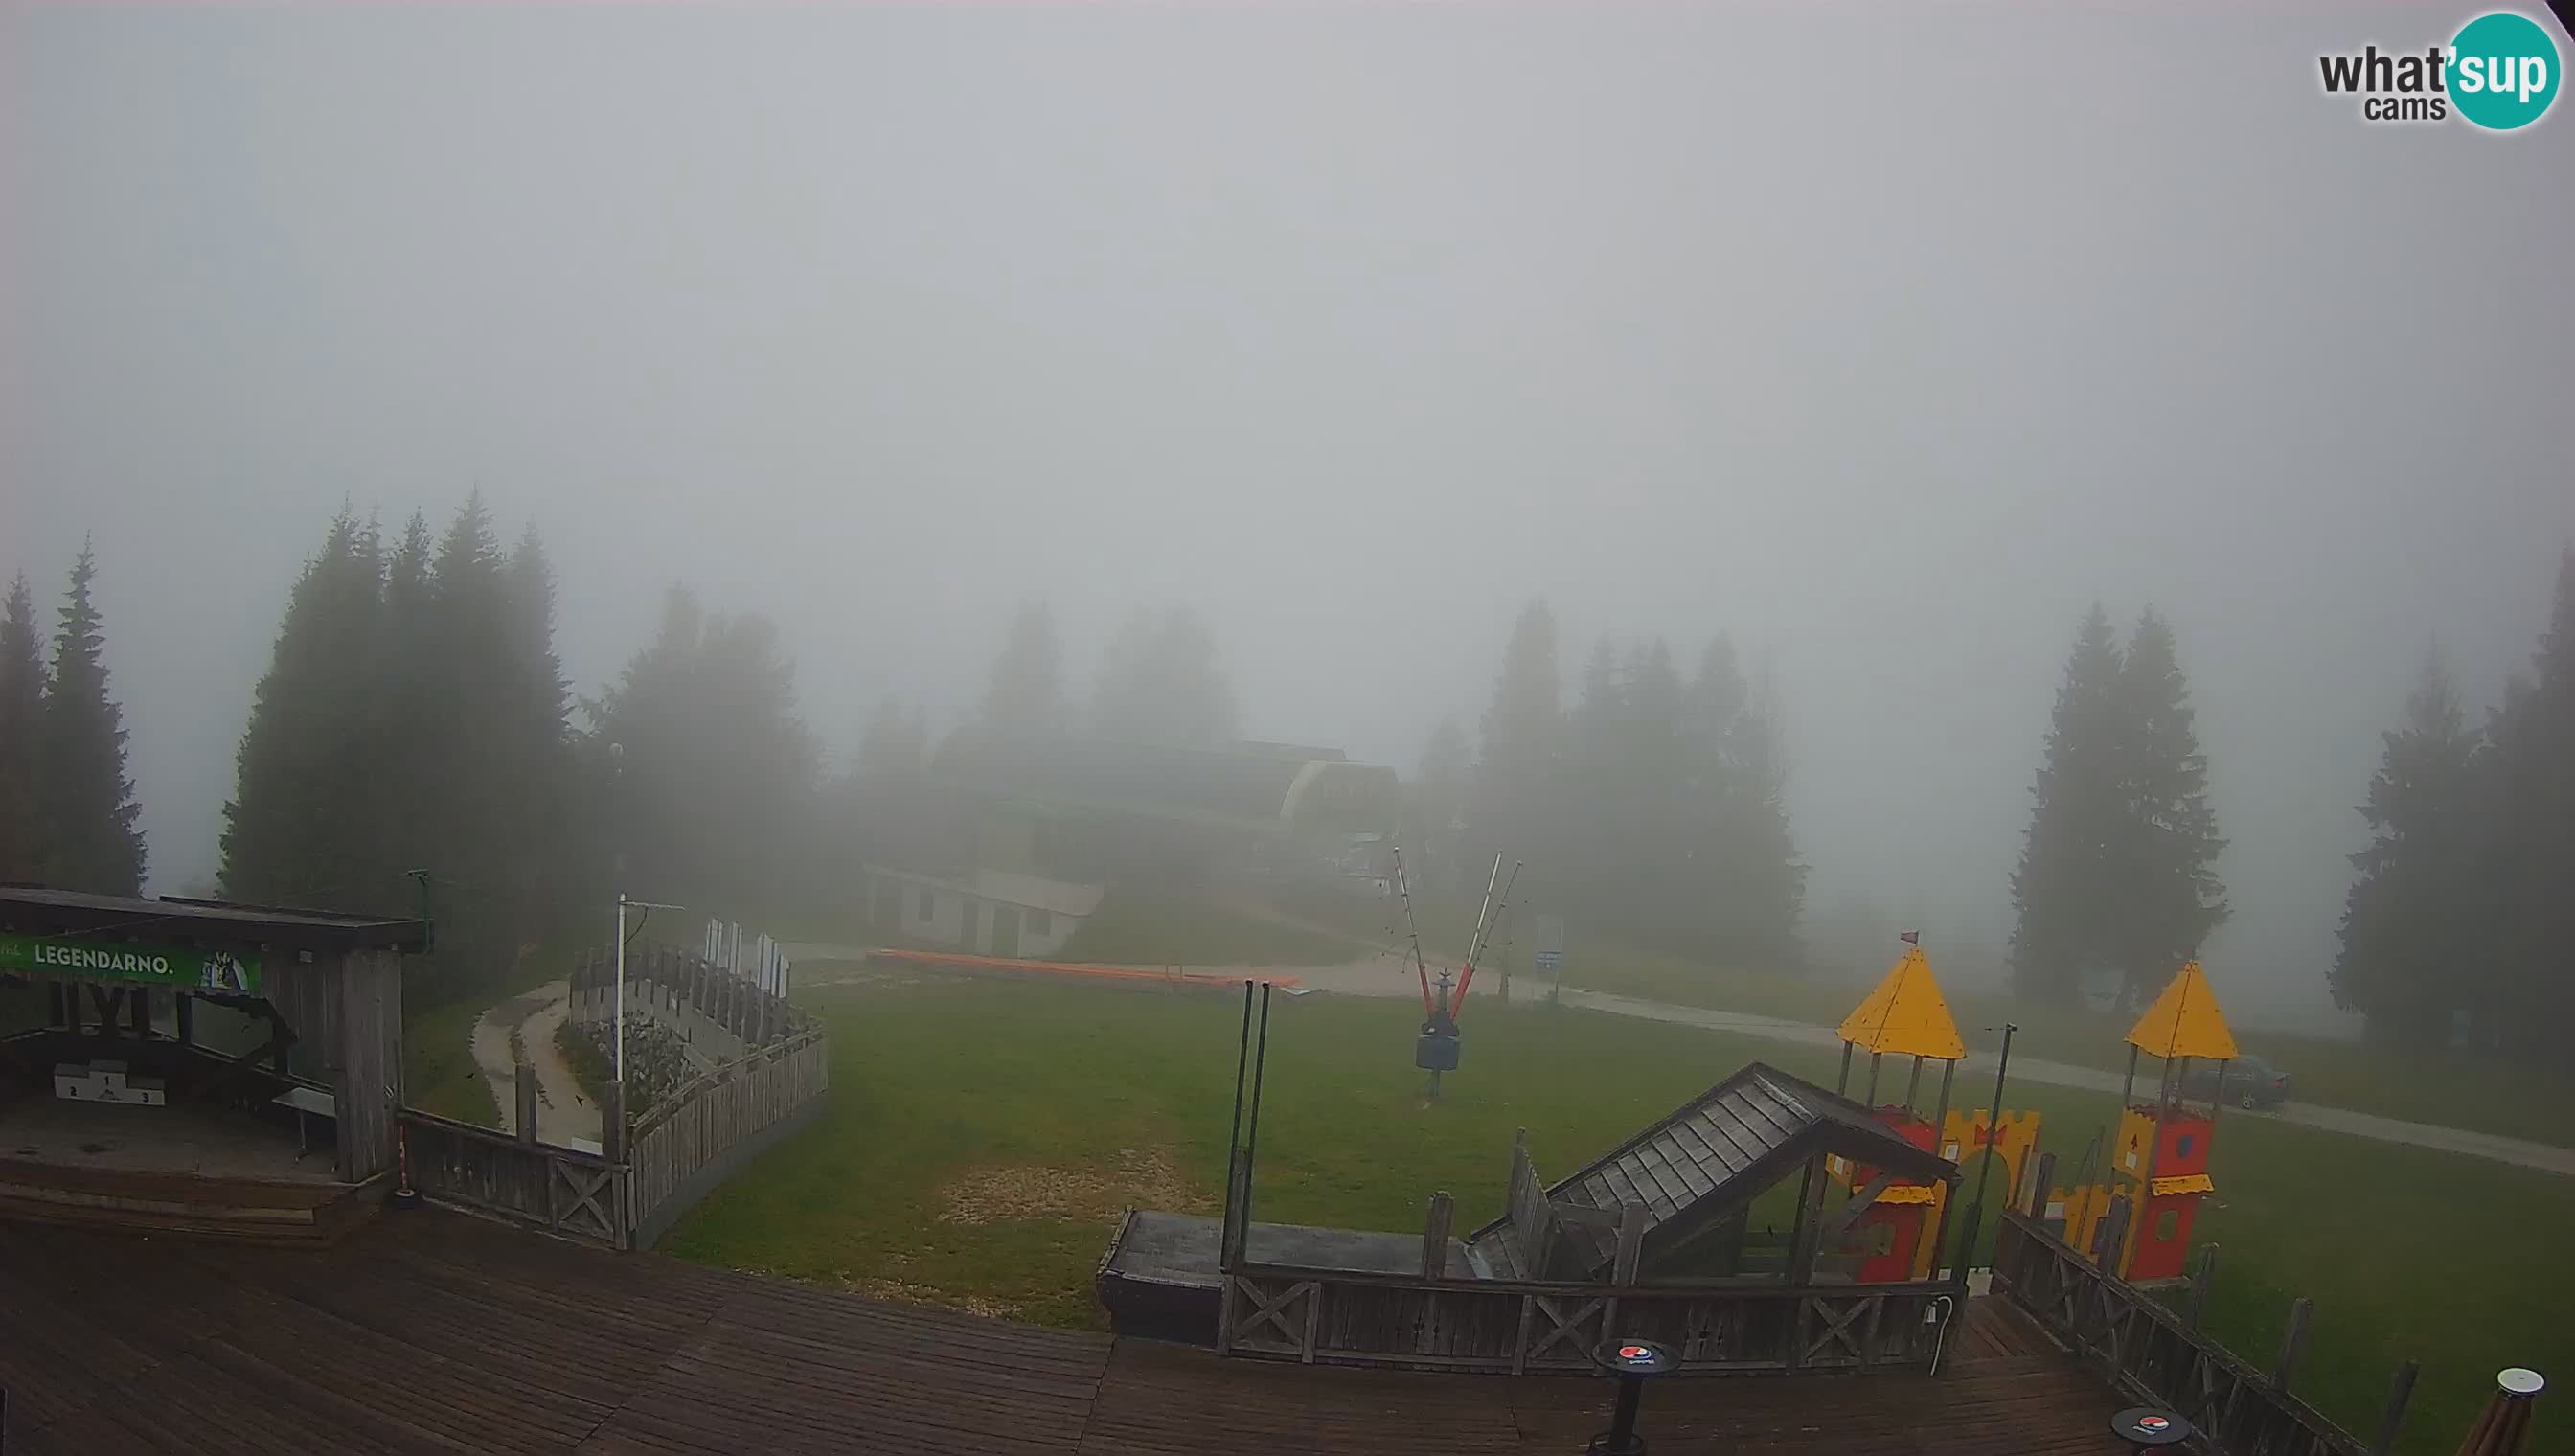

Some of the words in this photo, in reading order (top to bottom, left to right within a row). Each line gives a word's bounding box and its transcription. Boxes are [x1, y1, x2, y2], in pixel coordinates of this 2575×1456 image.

[34, 944, 175, 976] LEGENDARNO.
[103, 1074, 110, 1086] 1
[69, 1085, 78, 1098] 2
[141, 1091, 150, 1103] 3
